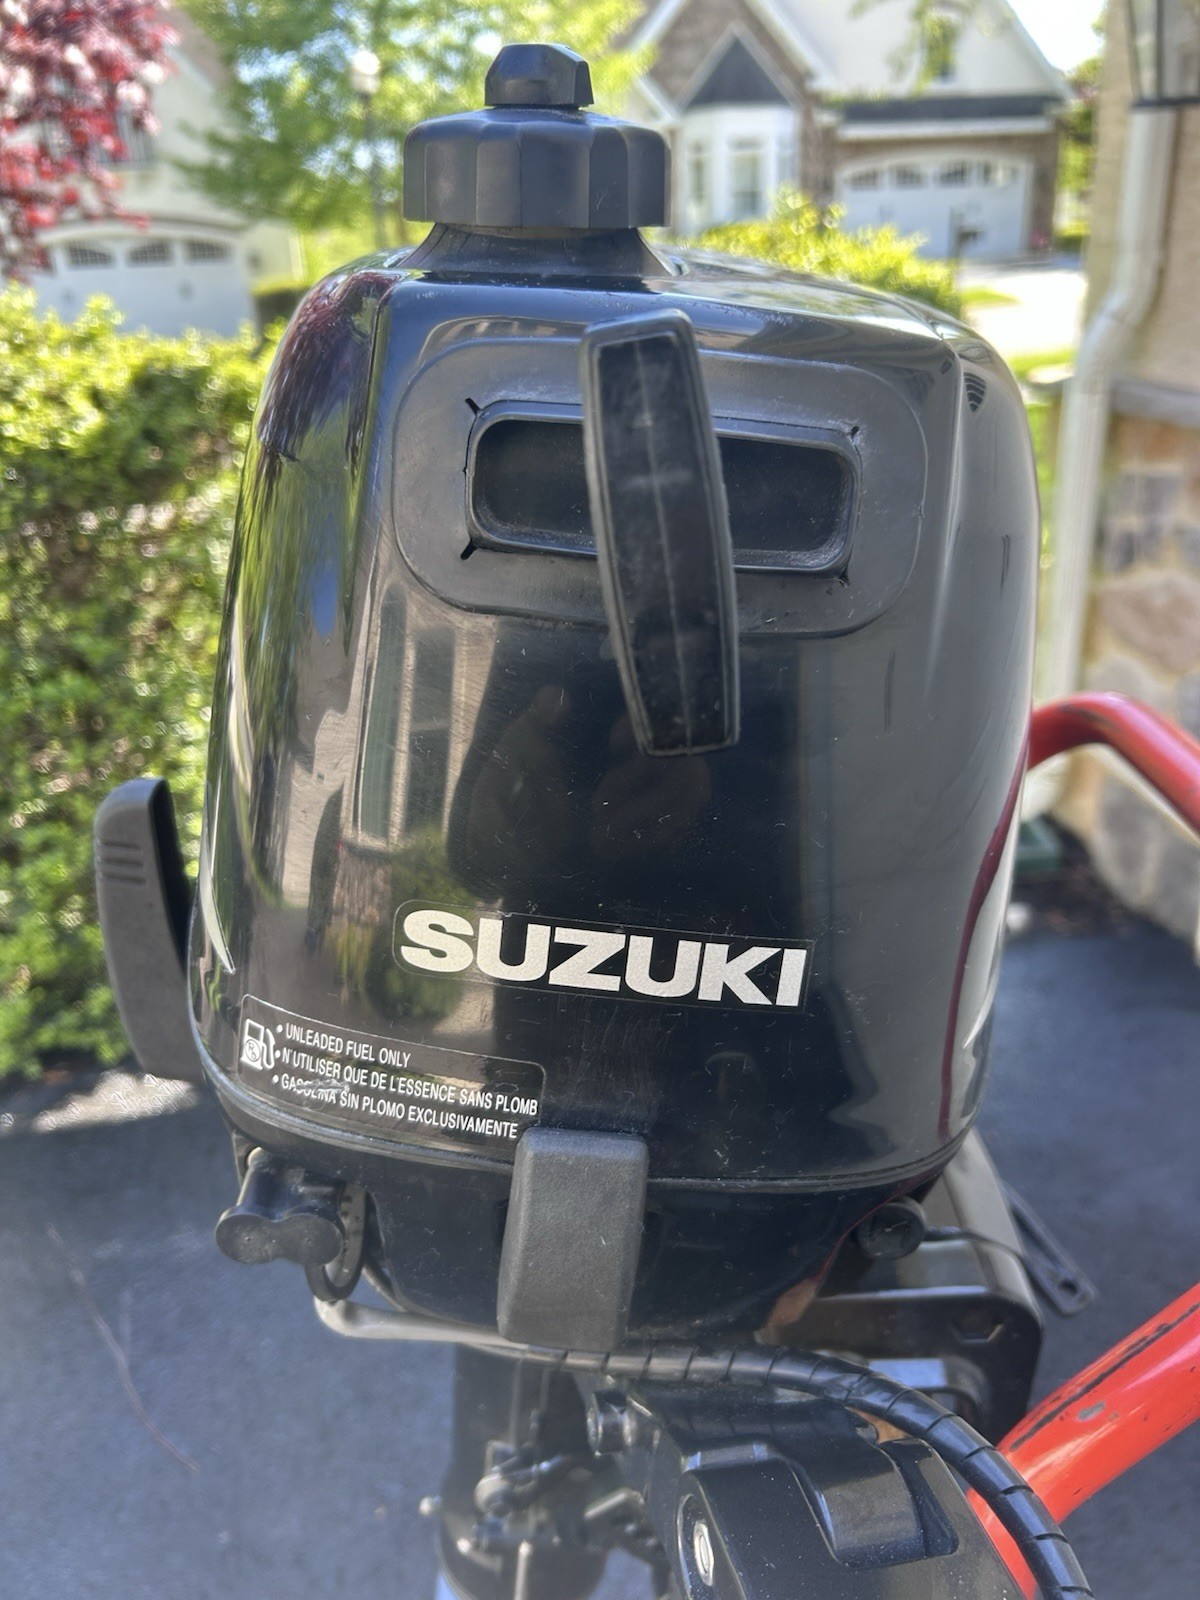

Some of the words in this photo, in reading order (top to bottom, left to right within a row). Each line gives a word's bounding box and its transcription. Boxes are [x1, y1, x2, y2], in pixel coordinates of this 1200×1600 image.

[400, 909, 808, 1007] SUZUKI
[285, 1022, 344, 1053] UNLEADED
[346, 1040, 376, 1061] FUEL
[379, 1047, 411, 1068] ONLY
[282, 1047, 341, 1079] N'UTILISER
[343, 1065, 368, 1085] QUE
[371, 1071, 388, 1090] DE
[390, 1075, 457, 1103] L'ESSENCE
[459, 1088, 492, 1109] SANS
[495, 1094, 538, 1116] PLOMB
[340, 1090, 360, 1110] SIN
[362, 1096, 406, 1119] PLOMO
[408, 1106, 519, 1139] EXCLUSIVAMENTE
